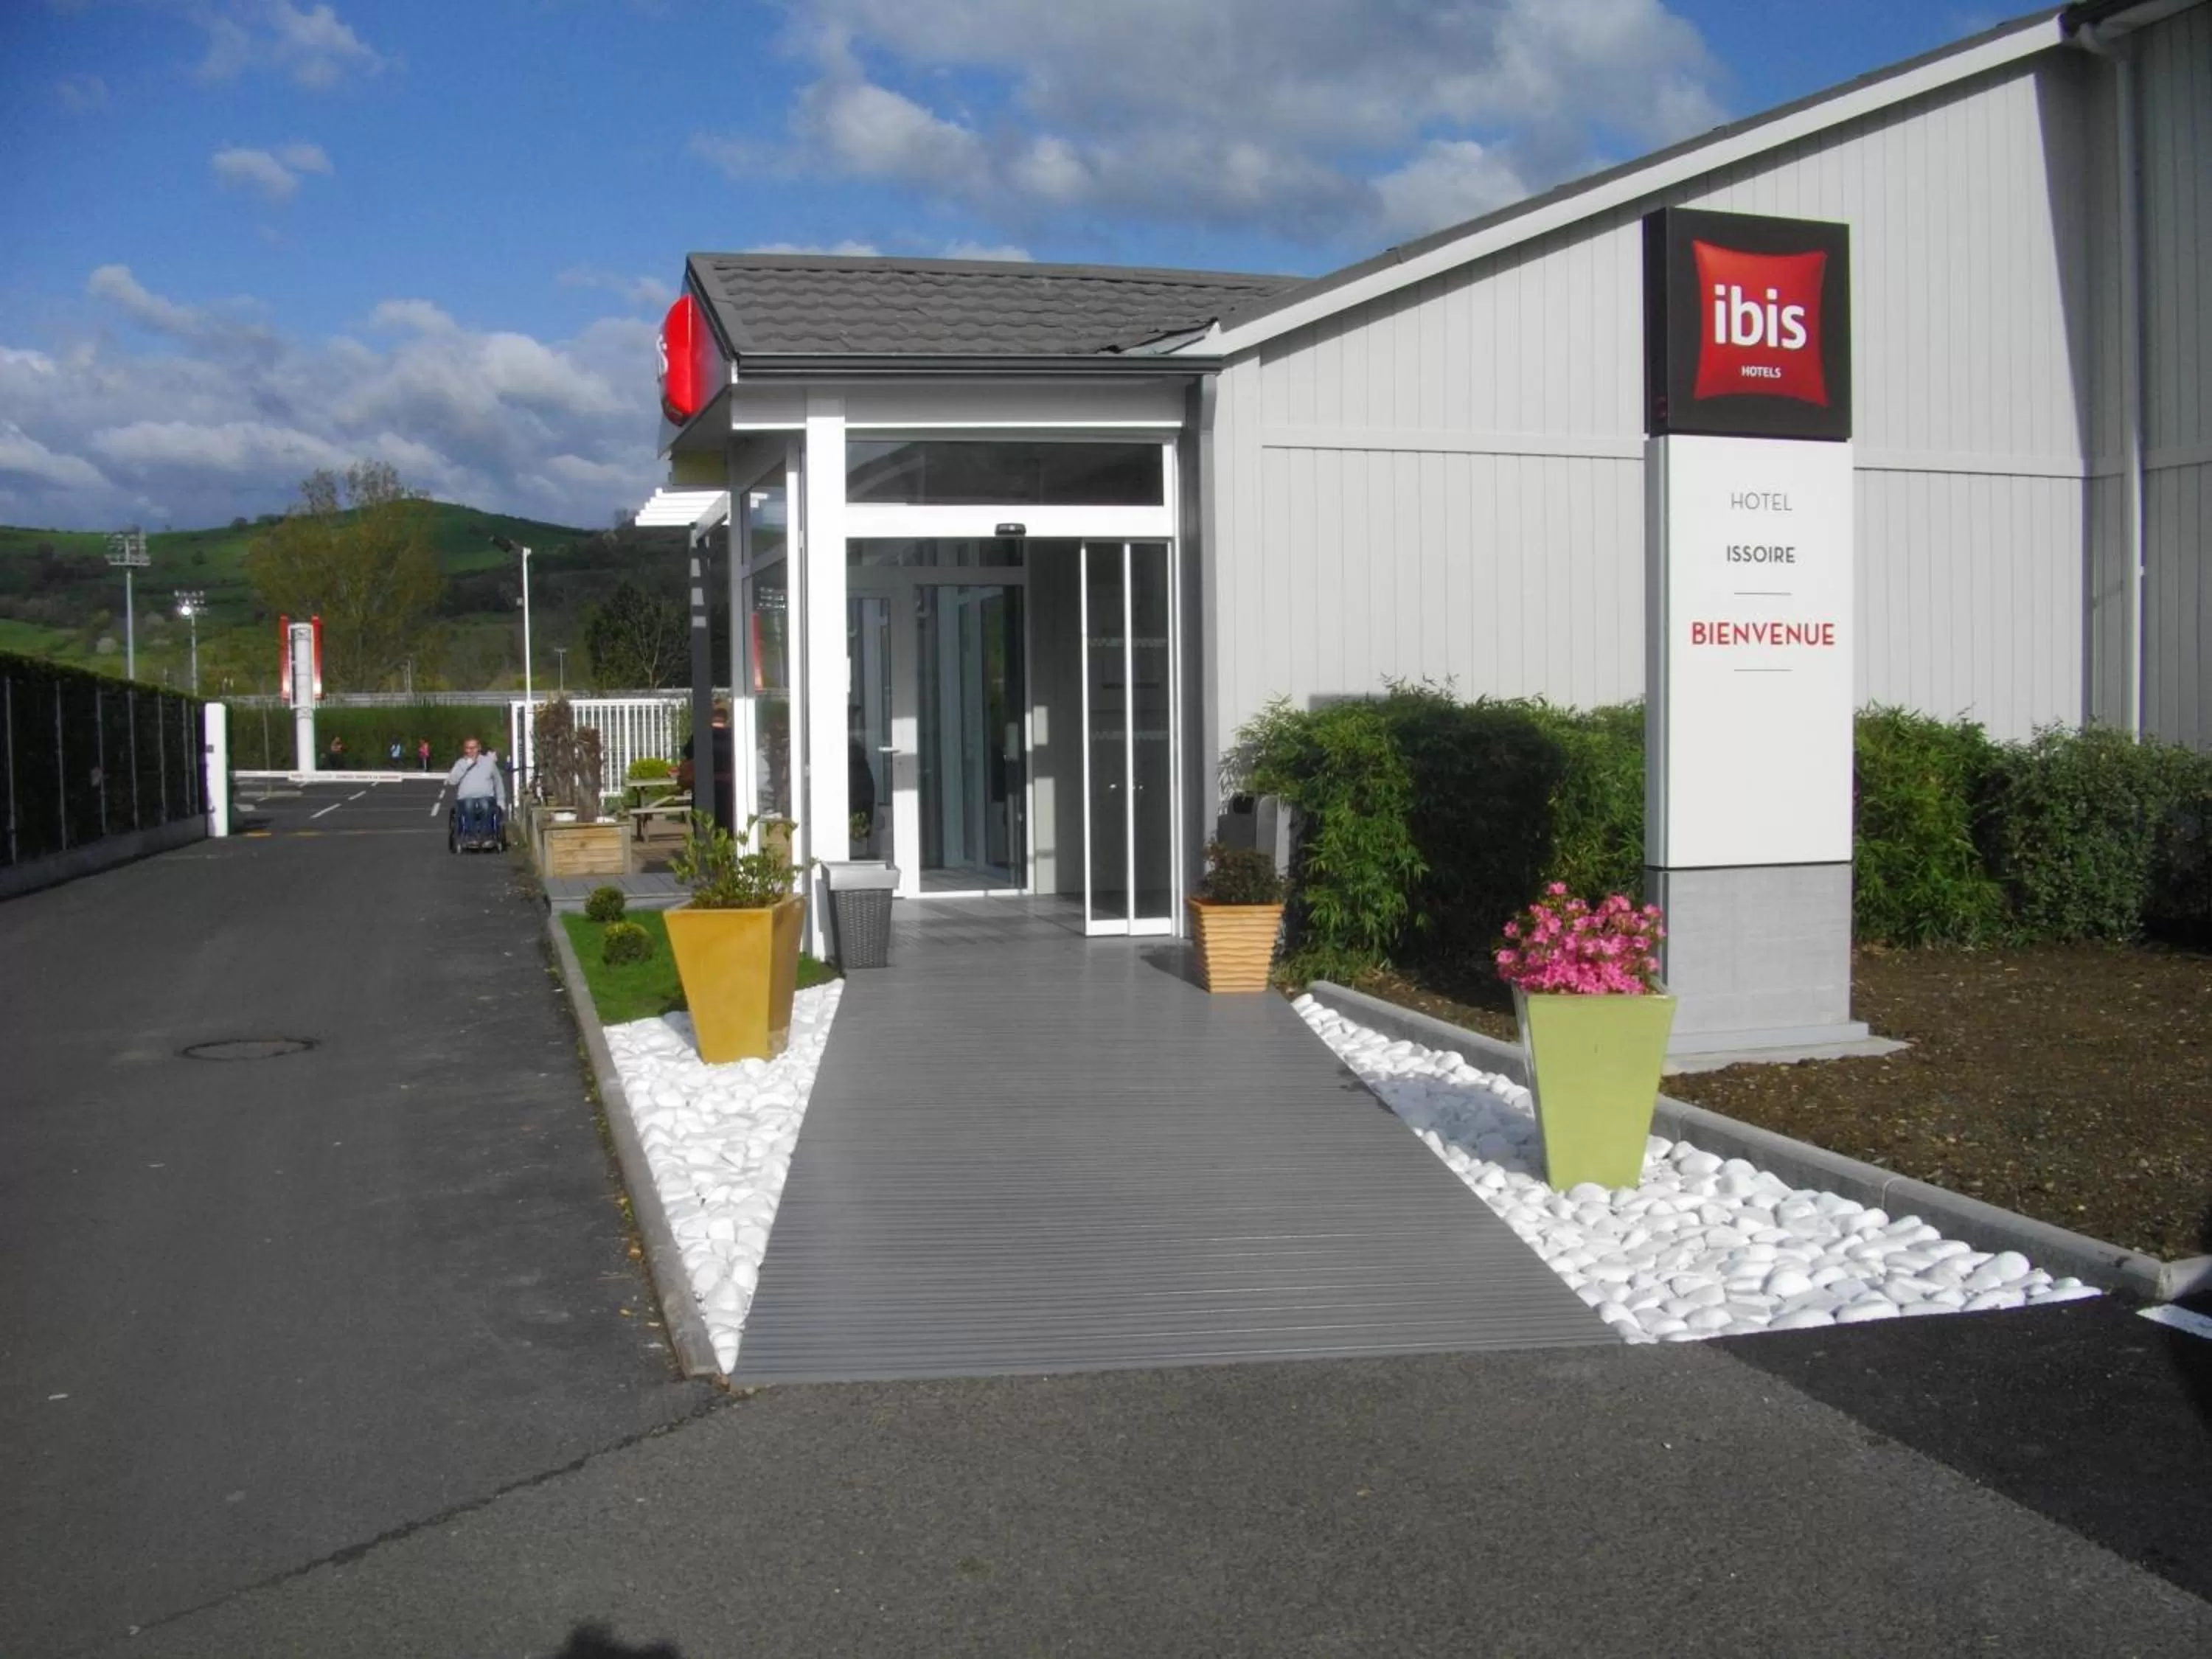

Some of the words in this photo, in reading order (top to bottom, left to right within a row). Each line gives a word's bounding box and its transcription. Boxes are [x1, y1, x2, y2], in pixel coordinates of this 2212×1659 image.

[1714, 284, 1806, 349] ibis
[1741, 366, 1781, 378] HOTELS
[1731, 492, 1792, 511] HOTEL
[1726, 545, 1796, 563] ISSOIRE
[1691, 622, 1835, 646] BIENVENUE
